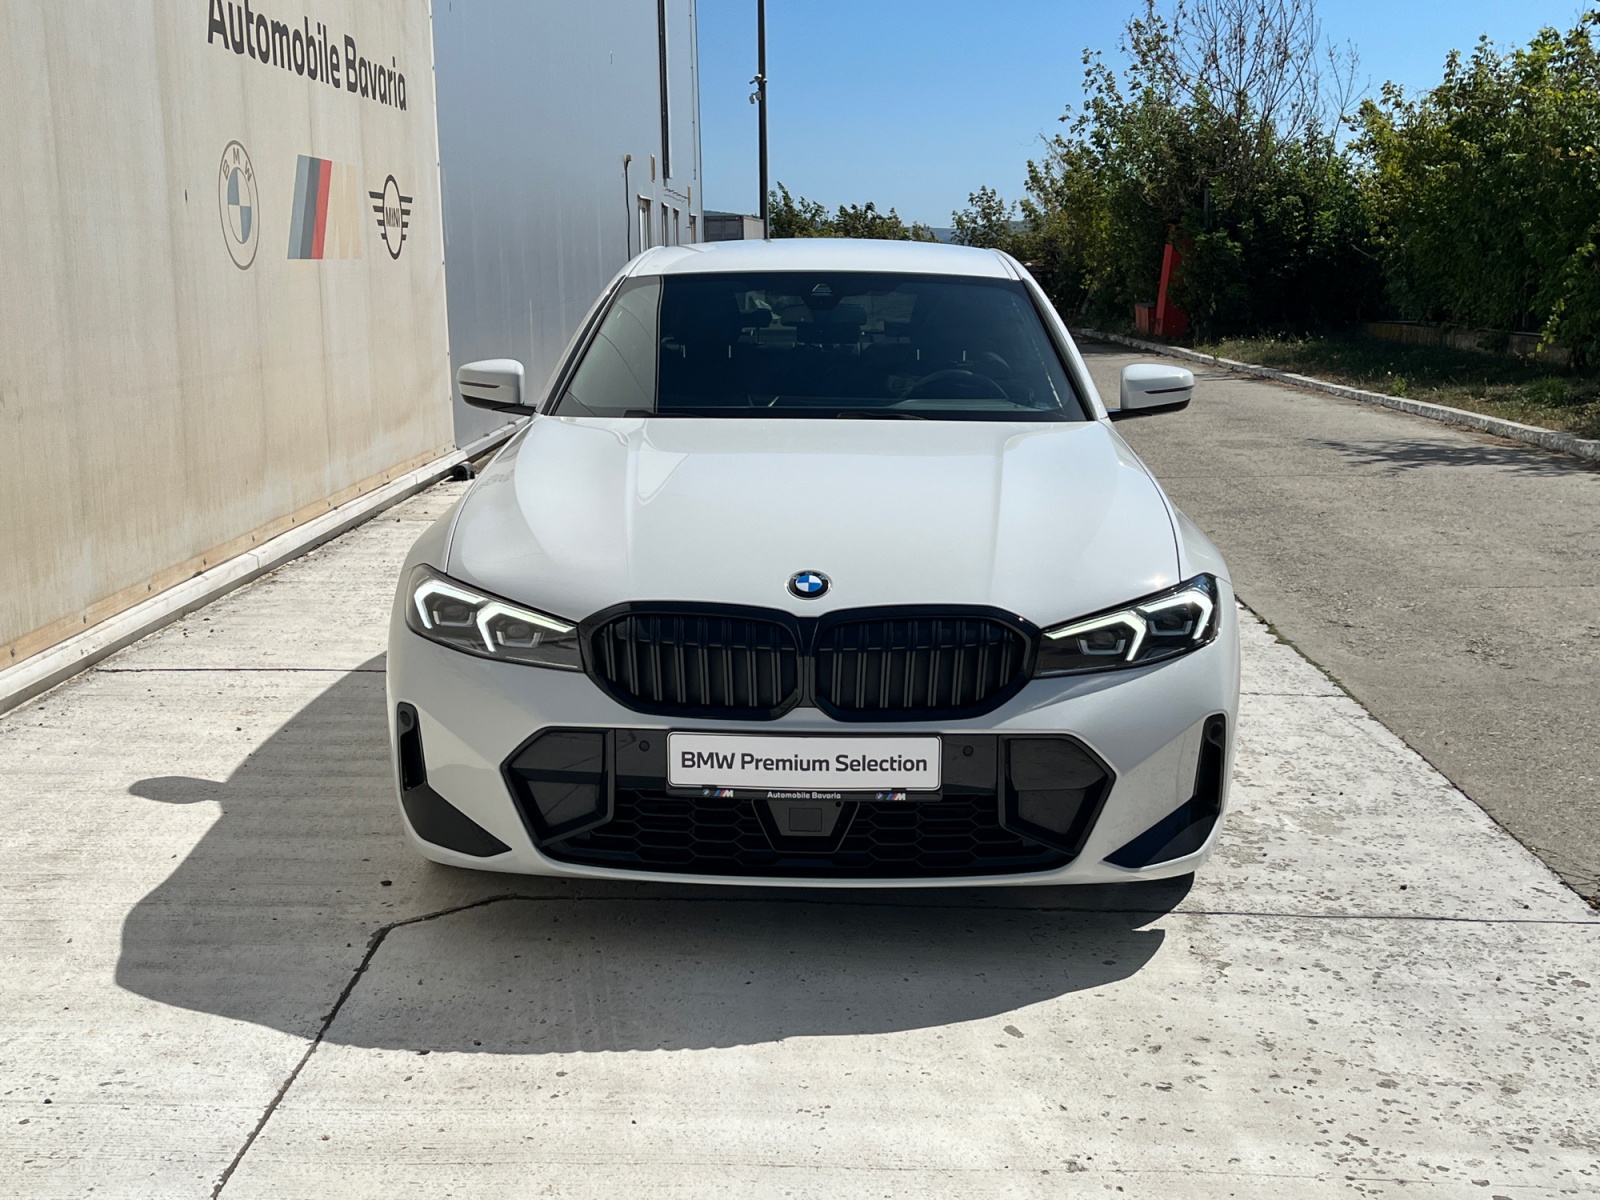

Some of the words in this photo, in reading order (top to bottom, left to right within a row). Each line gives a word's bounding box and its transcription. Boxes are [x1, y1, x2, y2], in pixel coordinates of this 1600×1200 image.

[207, 0, 341, 89] Automobile
[344, 34, 407, 111] Bavaria
[222, 147, 252, 182] BMW
[385, 206, 401, 228] MINI
[681, 751, 735, 770] BMW
[741, 753, 830, 771] Premium
[835, 754, 928, 772] Selection
[767, 791, 810, 799] Automobile
